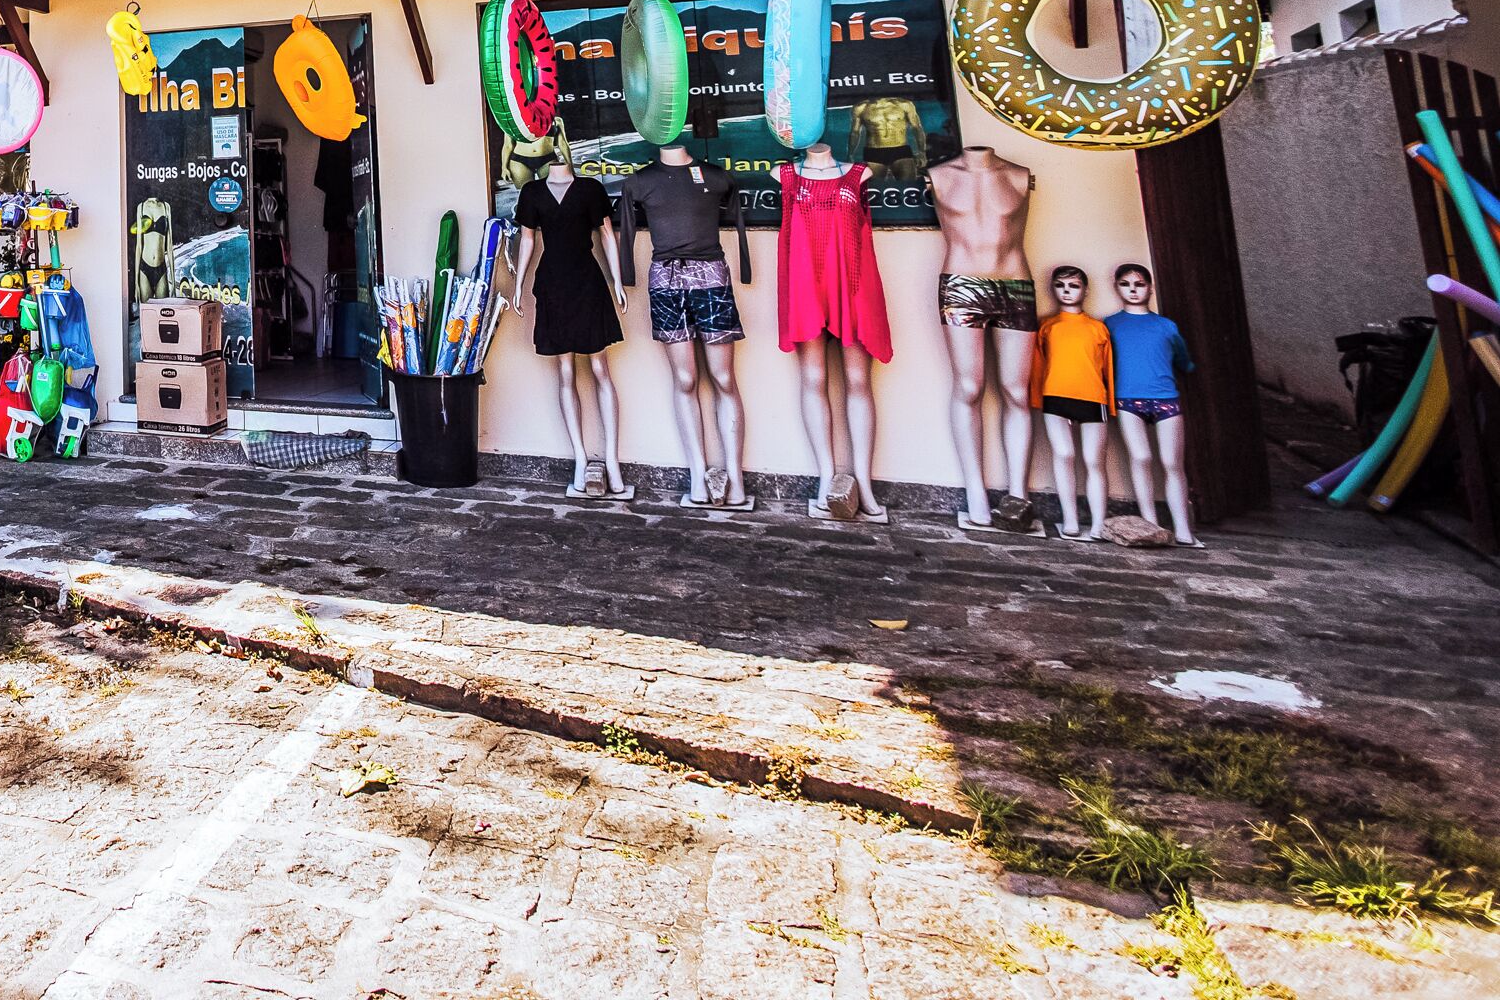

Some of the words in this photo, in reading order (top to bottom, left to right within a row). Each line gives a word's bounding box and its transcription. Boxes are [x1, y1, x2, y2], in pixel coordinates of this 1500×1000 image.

[888, 73, 935, 85] Etc.
[137, 163, 179, 183] Sungas
[187, 162, 221, 182] Bojos
[230, 160, 248, 178] Co
[179, 278, 241, 306] Charles
